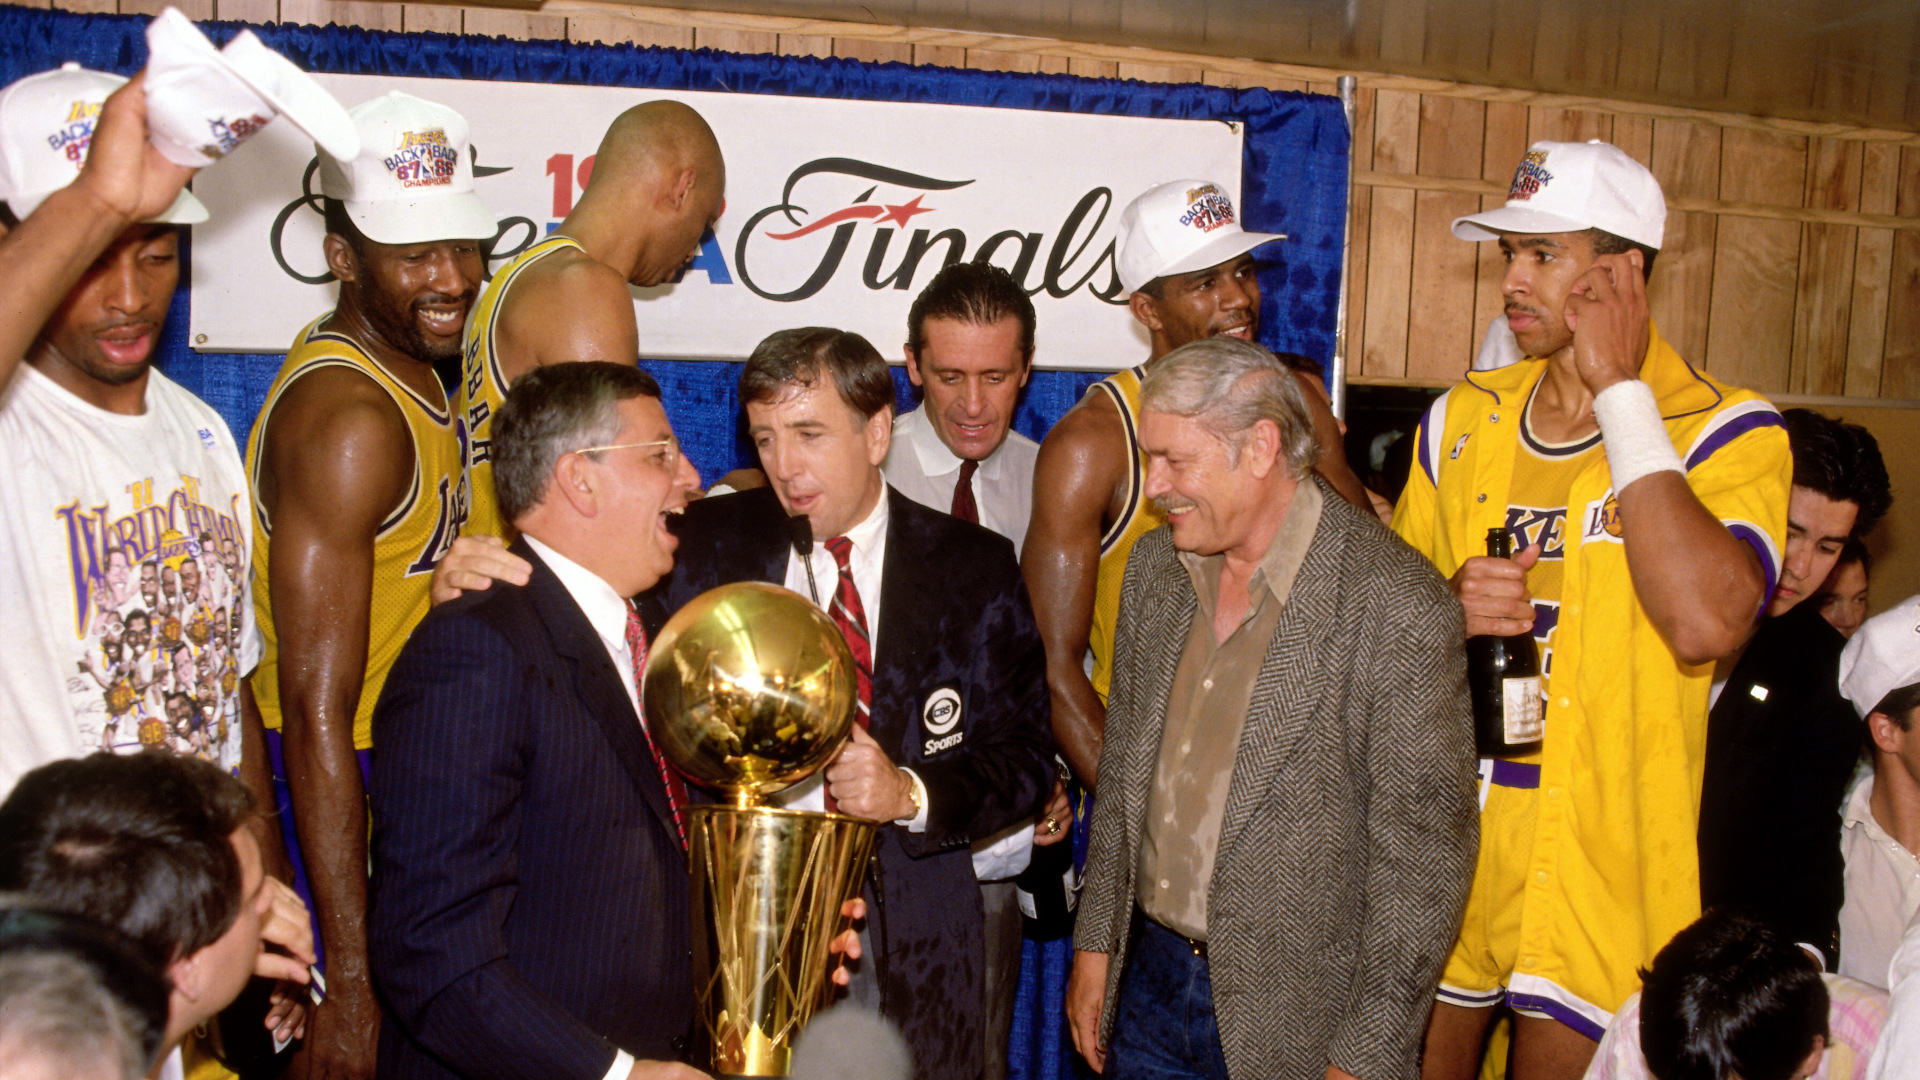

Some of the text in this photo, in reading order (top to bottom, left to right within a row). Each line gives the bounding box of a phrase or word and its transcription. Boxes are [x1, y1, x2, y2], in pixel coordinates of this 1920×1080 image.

[397, 129, 448, 150] LAKERS
[384, 147, 420, 172] BACK
[396, 158, 455, 180] 87 88
[403, 176, 452, 188] CHAMPIONS
[1520, 175, 1541, 194] 88
[1525, 163, 1554, 187] BACK
[1179, 198, 1209, 226] BACK
[1193, 208, 1213, 229] 87
[735, 157, 1131, 306] Finals
[933, 705, 952, 718] CBS
[924, 731, 964, 756] SPORTS
